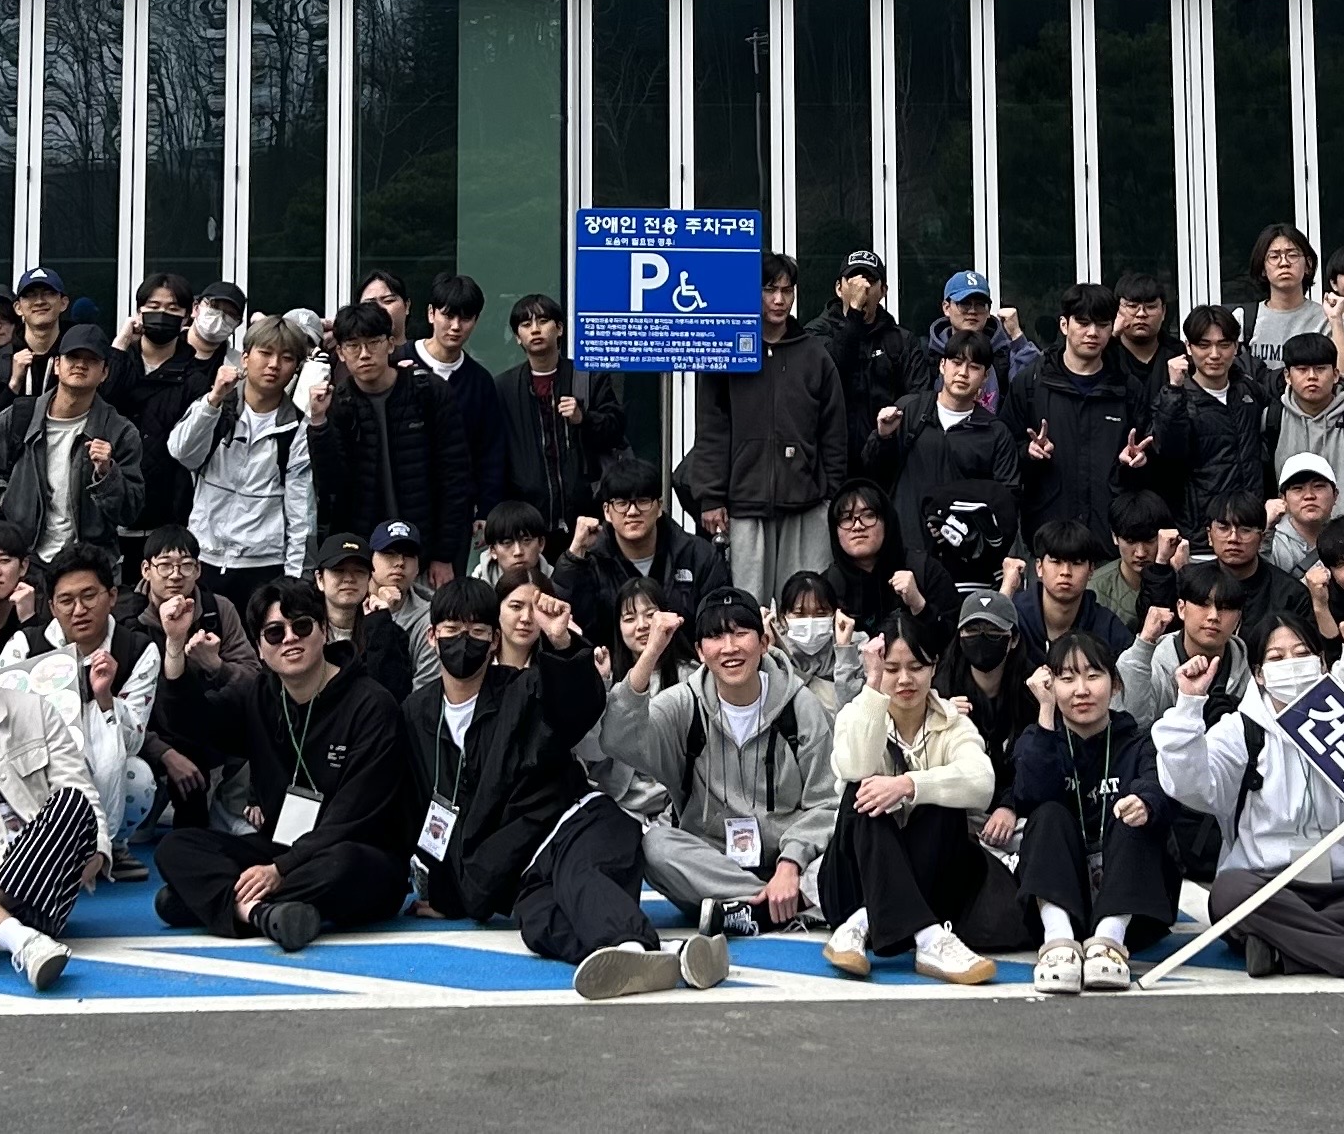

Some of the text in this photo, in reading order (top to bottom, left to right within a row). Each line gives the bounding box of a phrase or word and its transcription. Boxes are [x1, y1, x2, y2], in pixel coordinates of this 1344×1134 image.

[584, 216, 755, 236] 장애인 전용 주차구역
[630, 253, 670, 312] P
